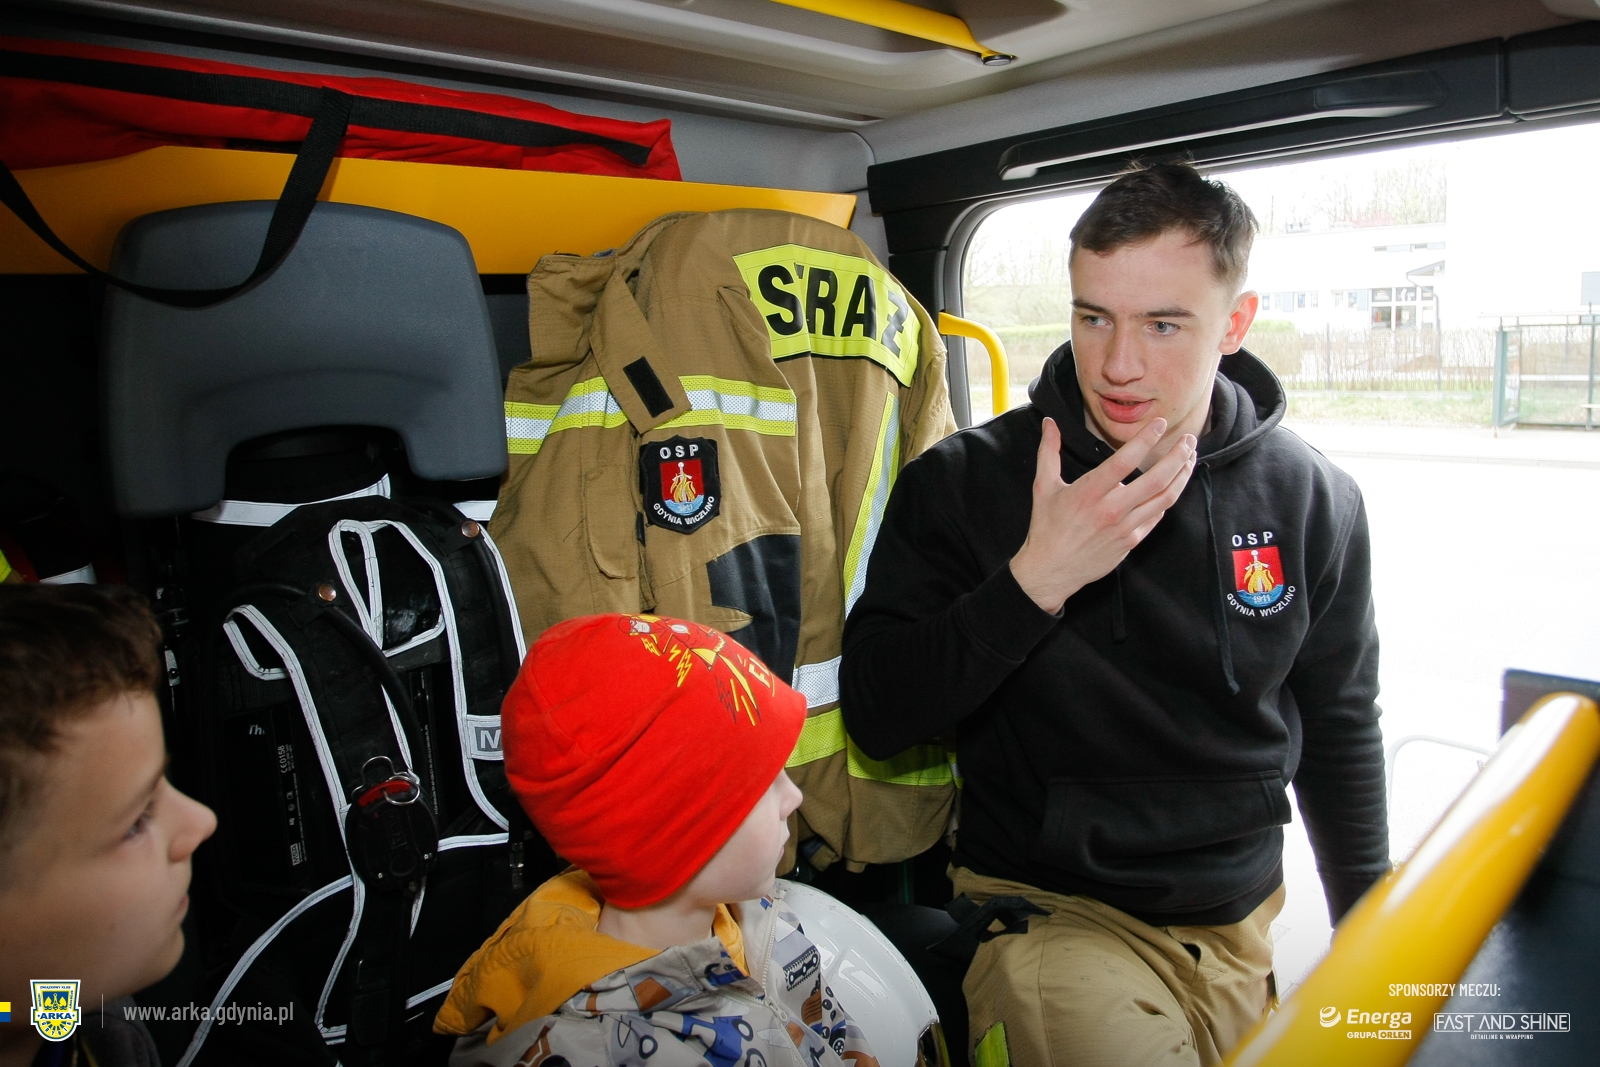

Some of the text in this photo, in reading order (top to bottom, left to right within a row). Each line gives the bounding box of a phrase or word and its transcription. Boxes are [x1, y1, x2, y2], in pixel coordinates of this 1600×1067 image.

[653, 496, 715, 525] GDYNIA WICZLINO
[1226, 585, 1296, 617] GDYNIA WICZLINO
